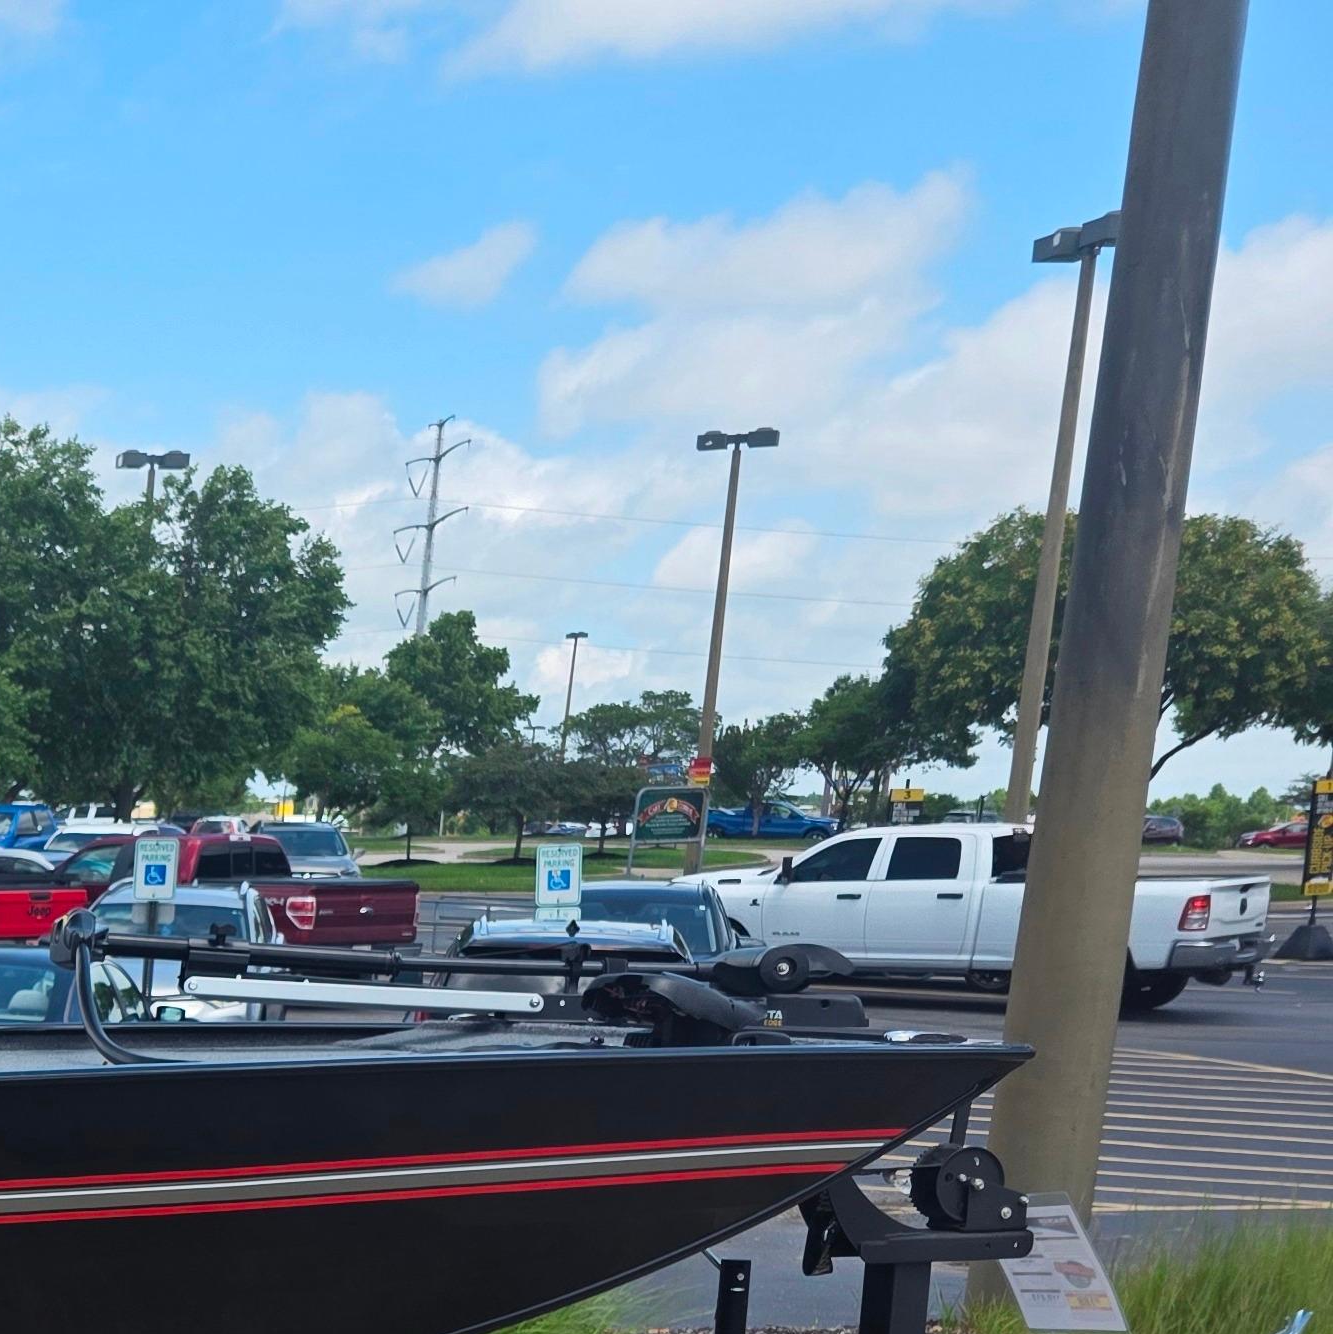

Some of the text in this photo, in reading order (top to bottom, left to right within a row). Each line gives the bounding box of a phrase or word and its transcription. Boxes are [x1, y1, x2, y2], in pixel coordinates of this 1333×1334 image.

[903, 790, 911, 800] 3
[139, 843, 175, 852] RESERVED
[541, 847, 579, 858] RESERVED
[141, 853, 171, 862] PARKING
[543, 858, 575, 868] PARKING
